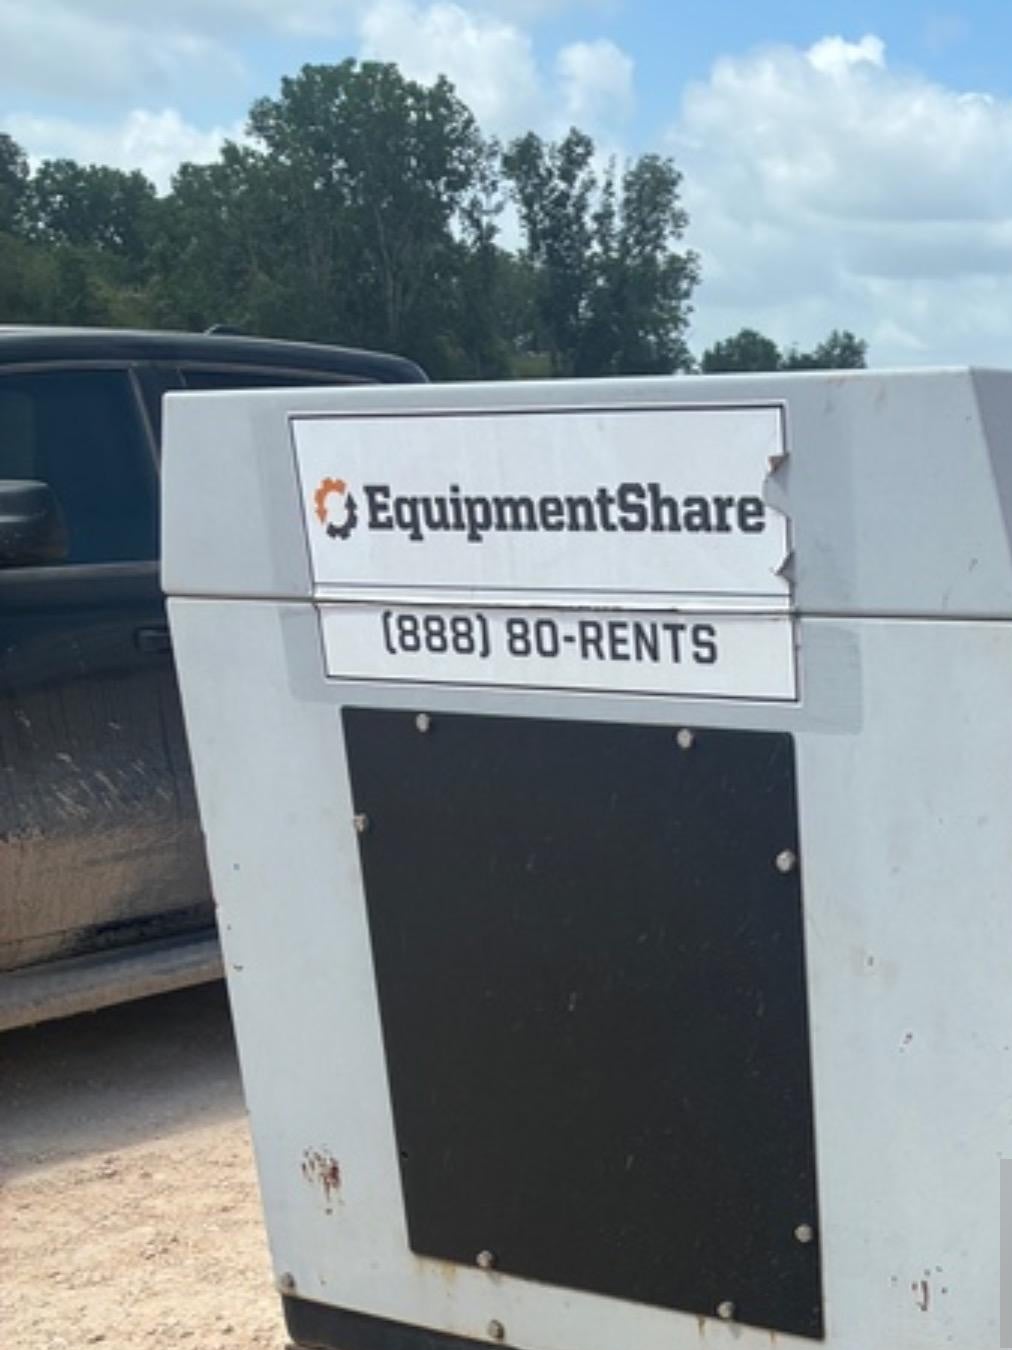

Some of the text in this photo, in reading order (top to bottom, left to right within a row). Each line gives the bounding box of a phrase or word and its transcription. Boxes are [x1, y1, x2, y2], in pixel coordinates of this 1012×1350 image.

[362, 482, 766, 542] EquipmentShare
[382, 610, 718, 665] (888) 80-RENTS
